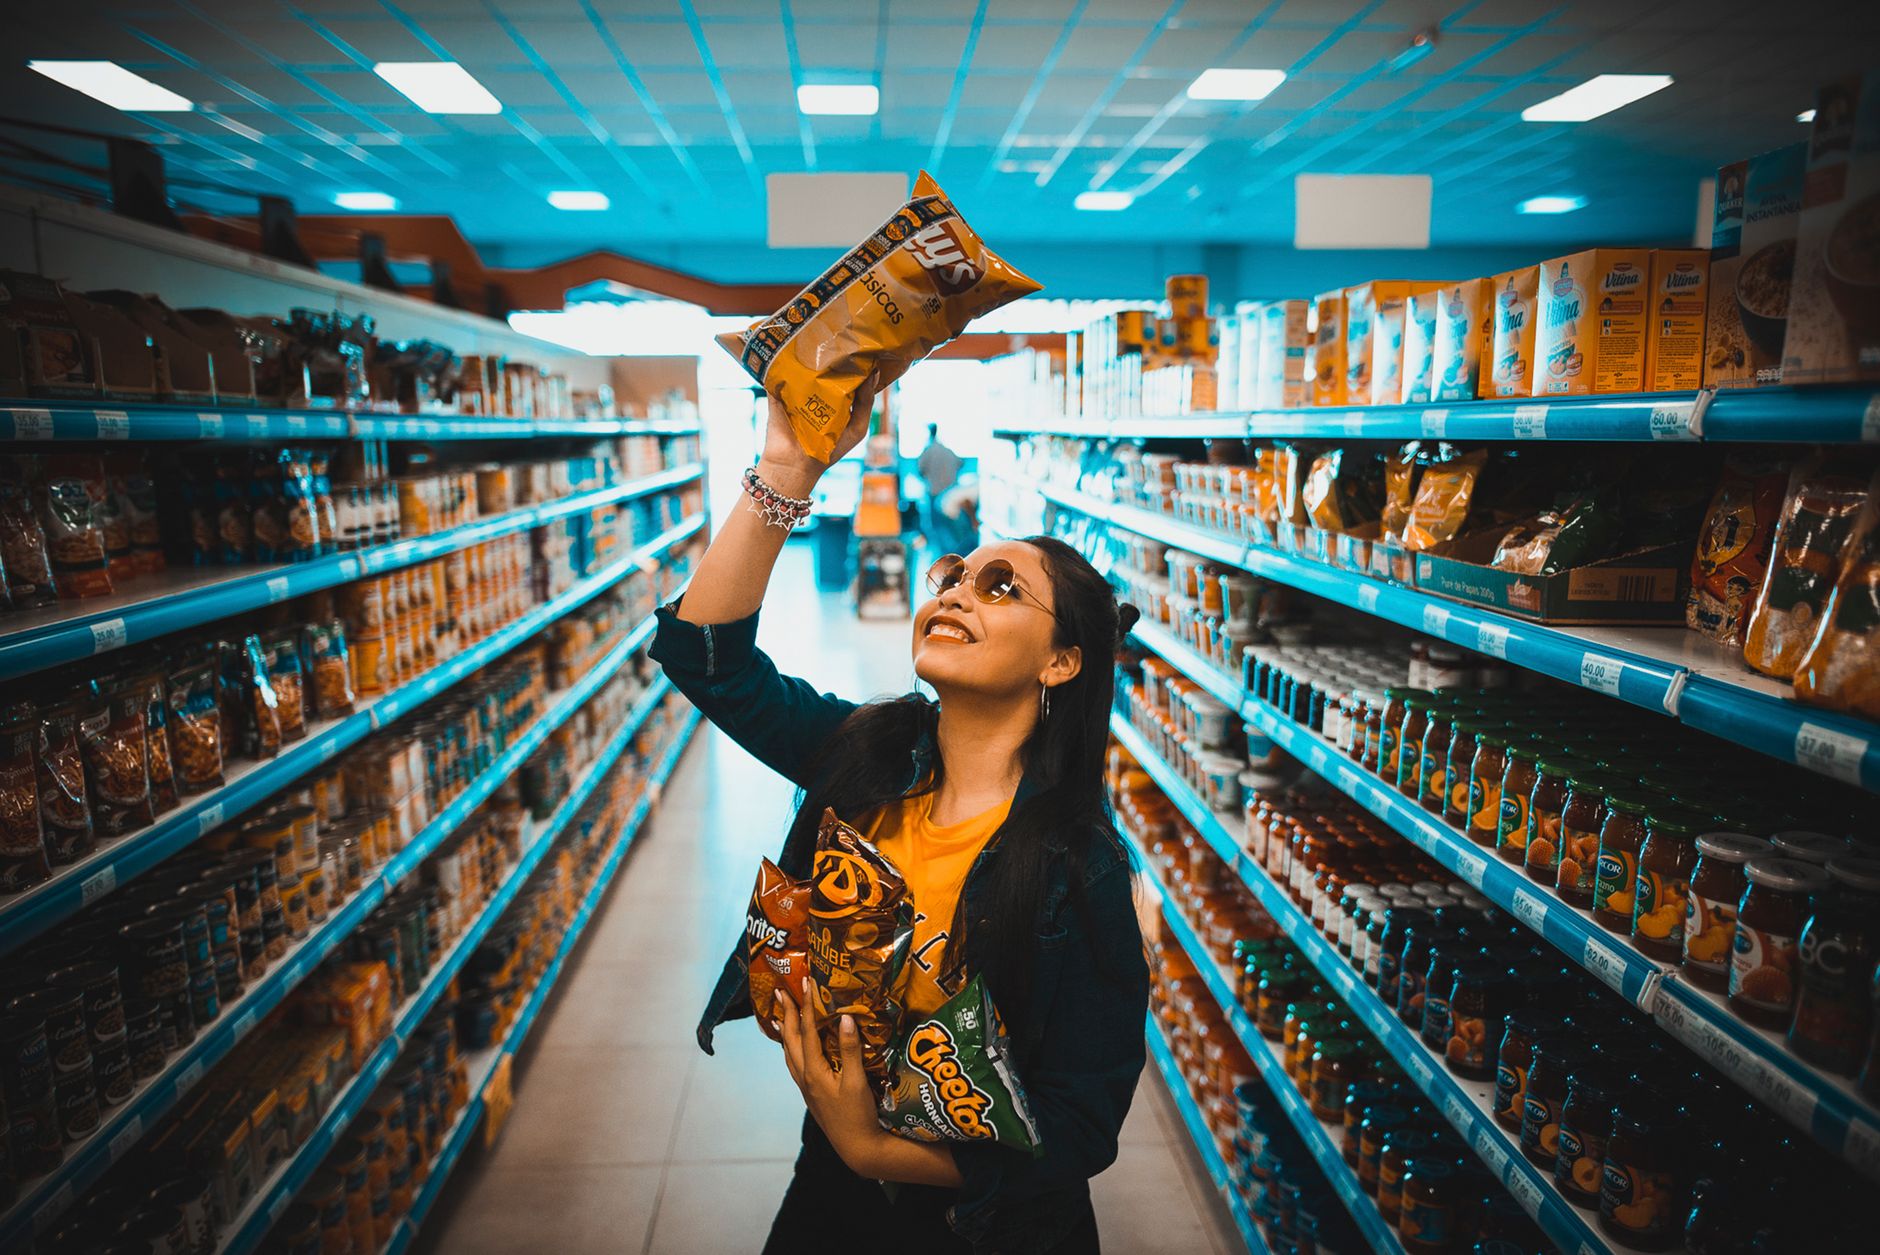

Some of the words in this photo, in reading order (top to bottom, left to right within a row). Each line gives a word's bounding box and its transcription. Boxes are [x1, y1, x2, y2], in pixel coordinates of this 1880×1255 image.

[1605, 272, 1639, 288] Vitina
[1666, 272, 1700, 288] Vitina
[805, 397, 831, 426] 105g
[908, 1025, 992, 1138] Cheetos
